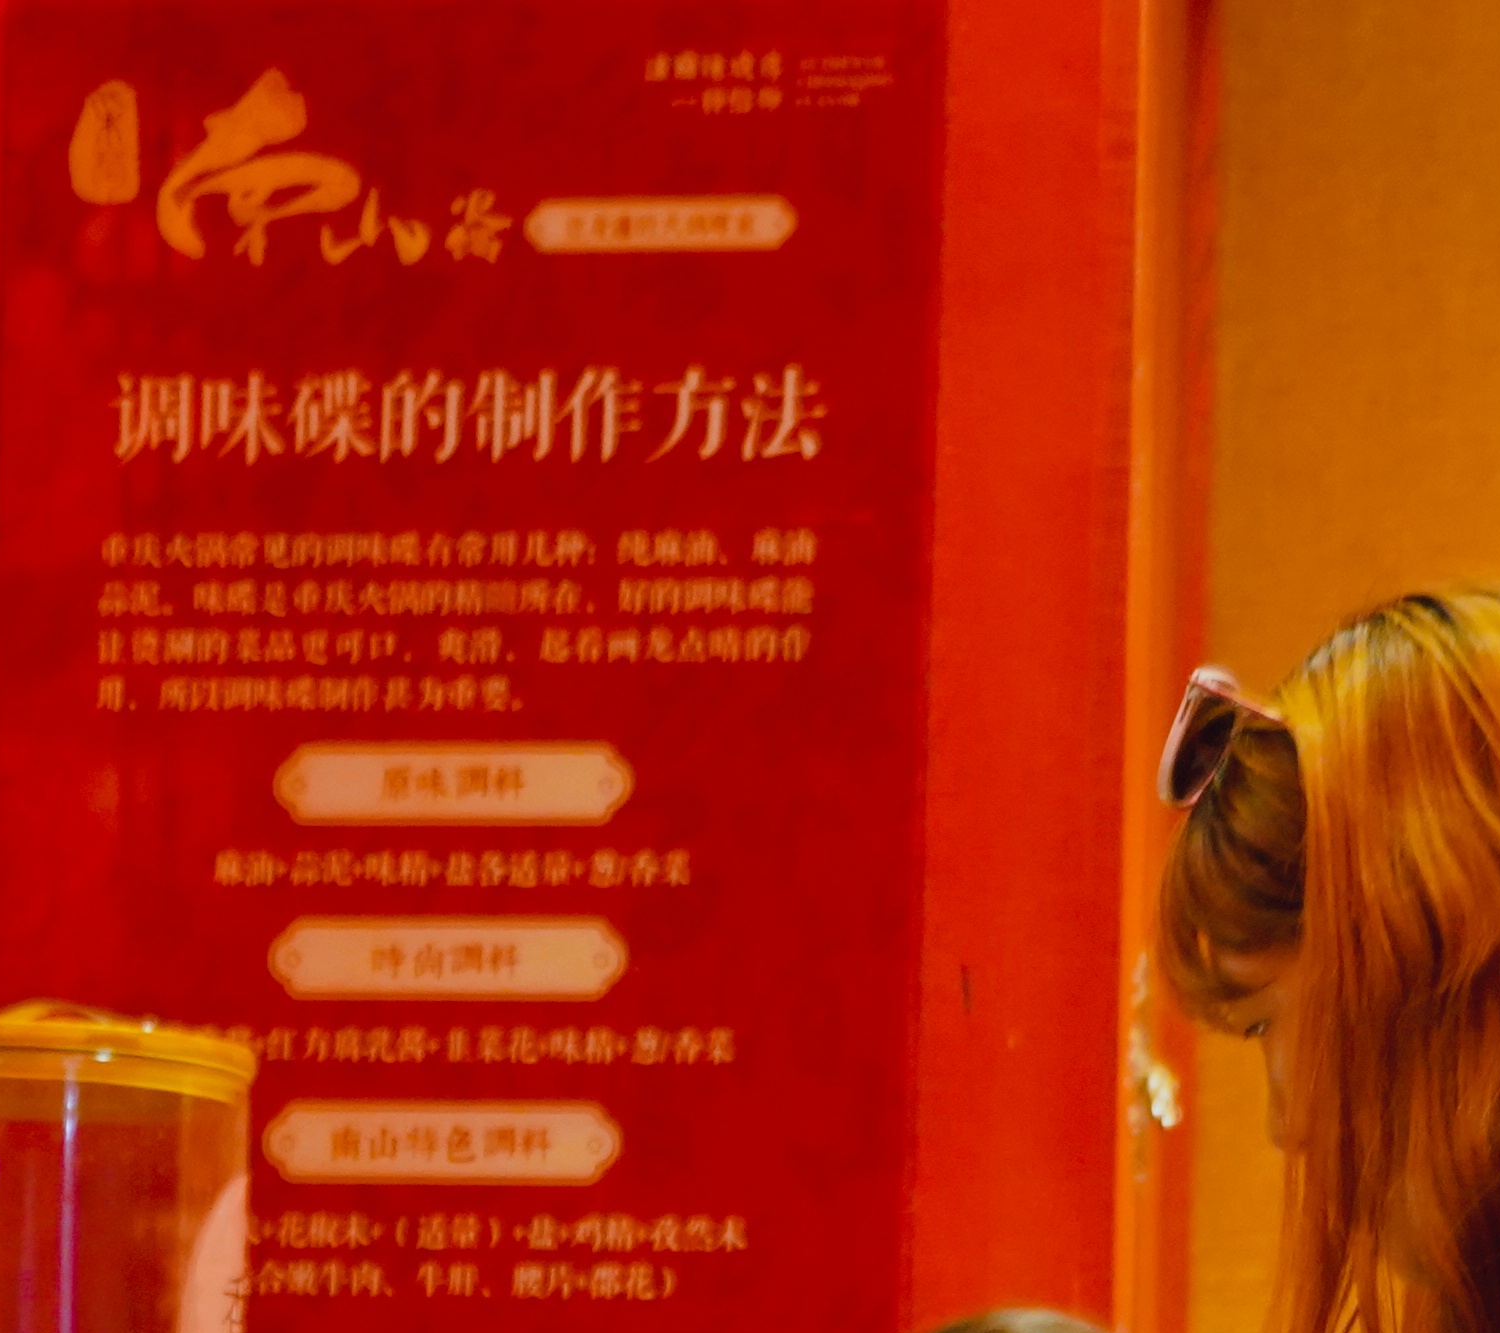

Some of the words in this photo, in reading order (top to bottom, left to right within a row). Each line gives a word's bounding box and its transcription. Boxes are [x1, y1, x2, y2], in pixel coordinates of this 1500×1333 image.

[111, 364, 828, 466] 调味碟的制作方法
